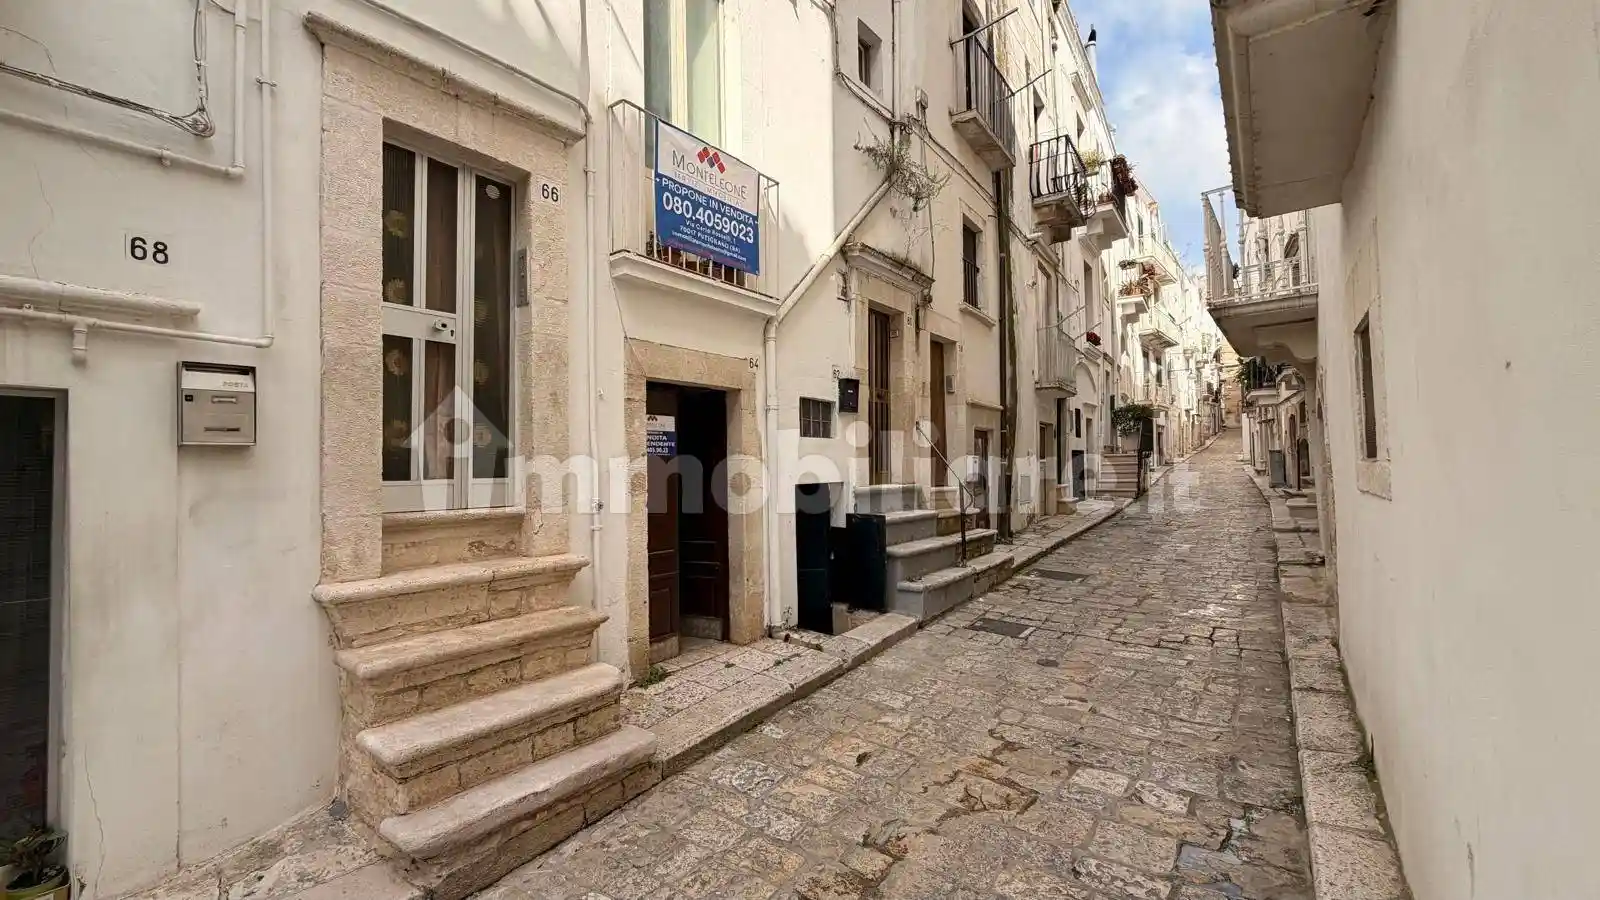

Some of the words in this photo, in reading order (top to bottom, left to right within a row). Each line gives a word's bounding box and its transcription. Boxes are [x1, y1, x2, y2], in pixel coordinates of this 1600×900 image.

[672, 150, 747, 199] MONTELEONE
[542, 183, 559, 202] 66
[662, 177, 707, 205] PROPONE
[709, 199, 718, 210] IN
[720, 203, 754, 225] VENDITA
[663, 191, 754, 244] 080.4059023
[685, 219, 693, 227] Via
[130, 236, 169, 265] 68
[697, 232, 729, 249] PUTIGNANO
[749, 357, 759, 369] 64
